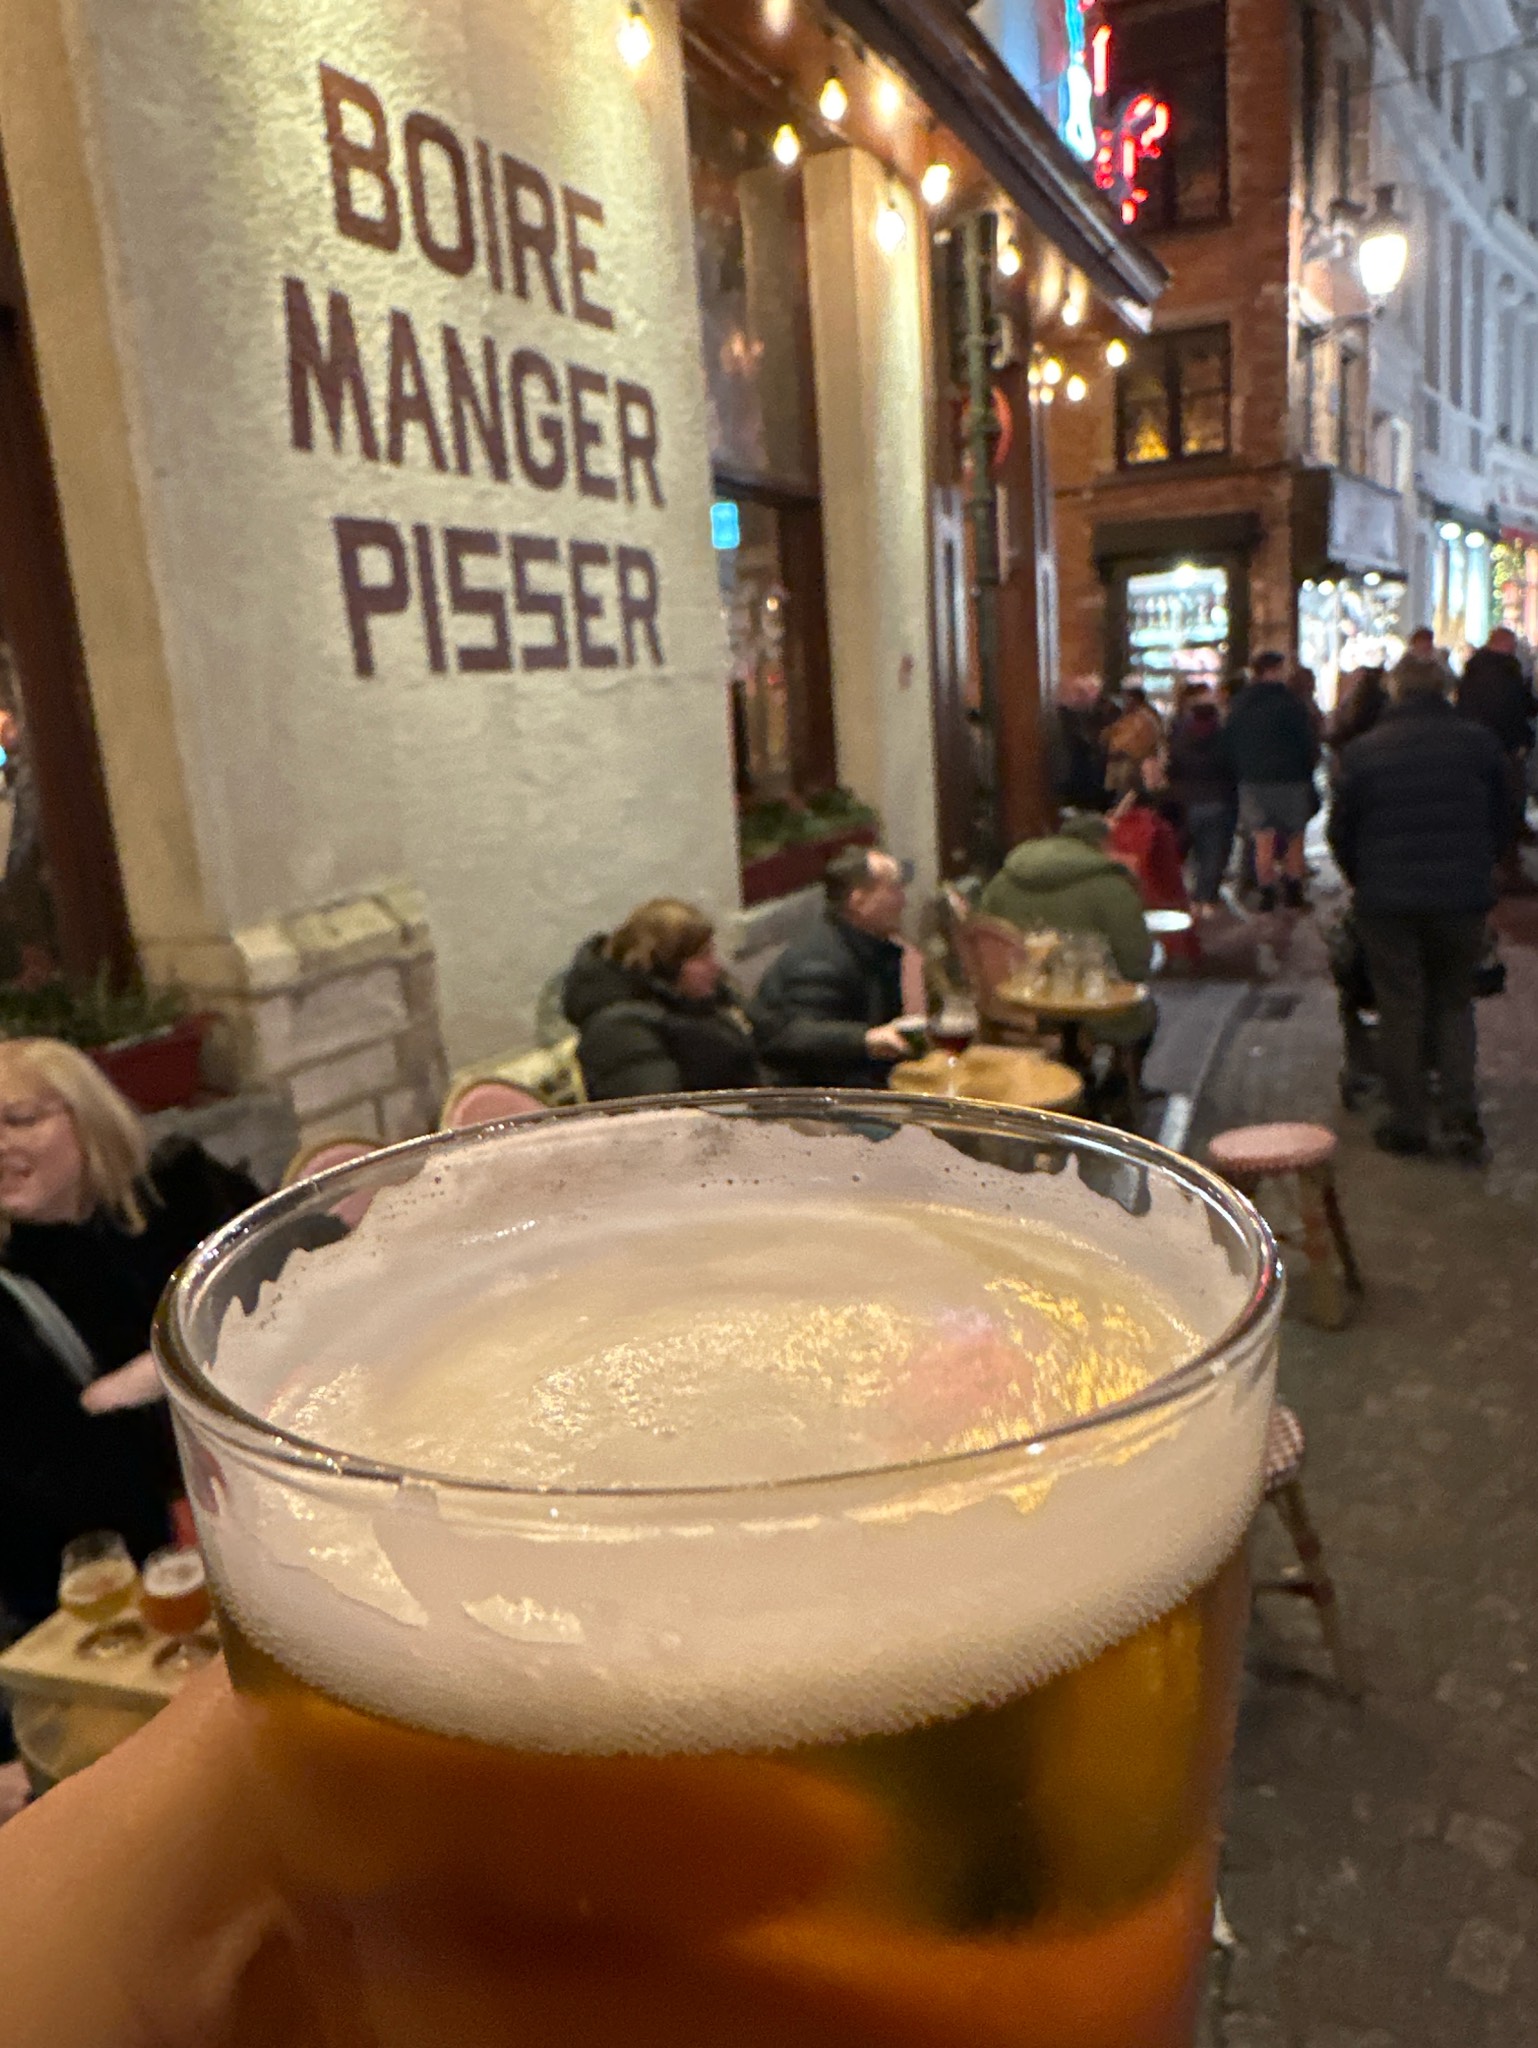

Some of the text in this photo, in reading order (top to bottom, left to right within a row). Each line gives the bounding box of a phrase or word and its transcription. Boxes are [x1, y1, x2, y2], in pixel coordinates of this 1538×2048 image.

[319, 62, 615, 329] BOIRE
[283, 276, 665, 508] MANGER
[333, 516, 665, 679] PISSER
